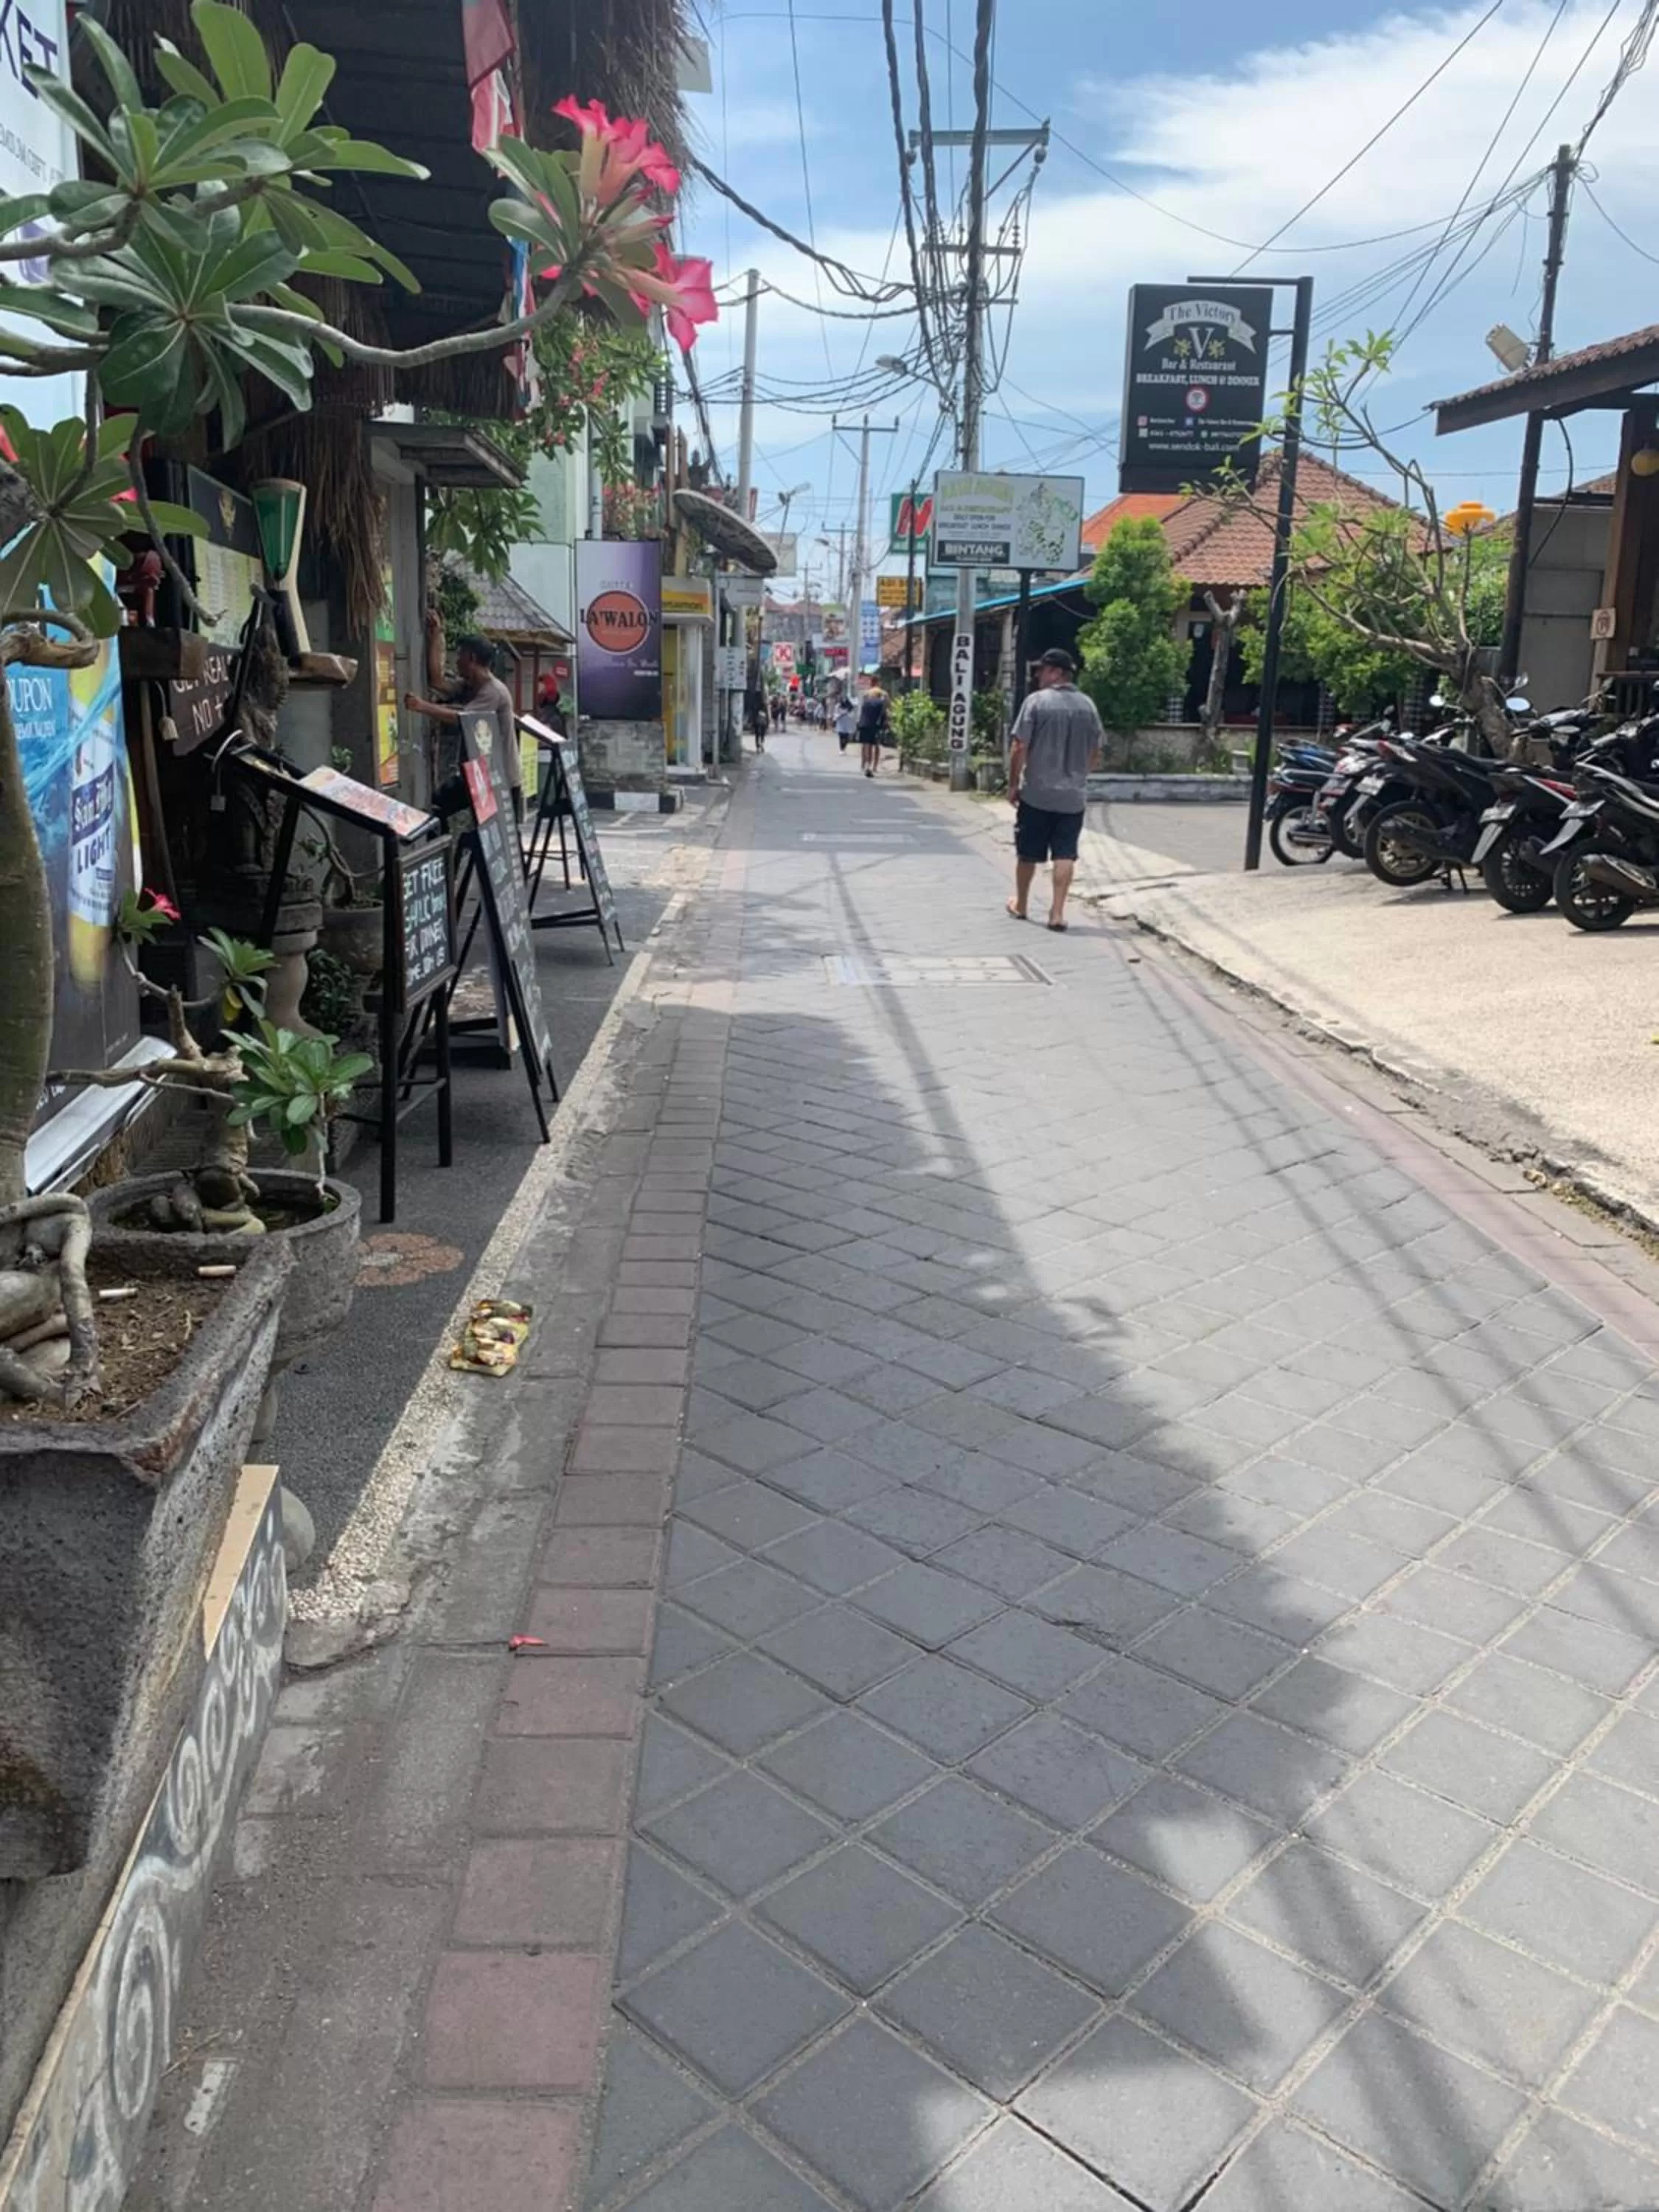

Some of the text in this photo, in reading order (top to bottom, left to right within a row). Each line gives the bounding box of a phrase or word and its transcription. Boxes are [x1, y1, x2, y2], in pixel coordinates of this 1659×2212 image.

[1170, 303, 1237, 324] The Victory
[1188, 327, 1216, 360] V
[1161, 358, 1237, 372] Bar & Restaurant
[945, 542, 1004, 556] BINTANG
[951, 636, 970, 749] BALI AGUNG
[77, 826, 111, 874] LIGHT
